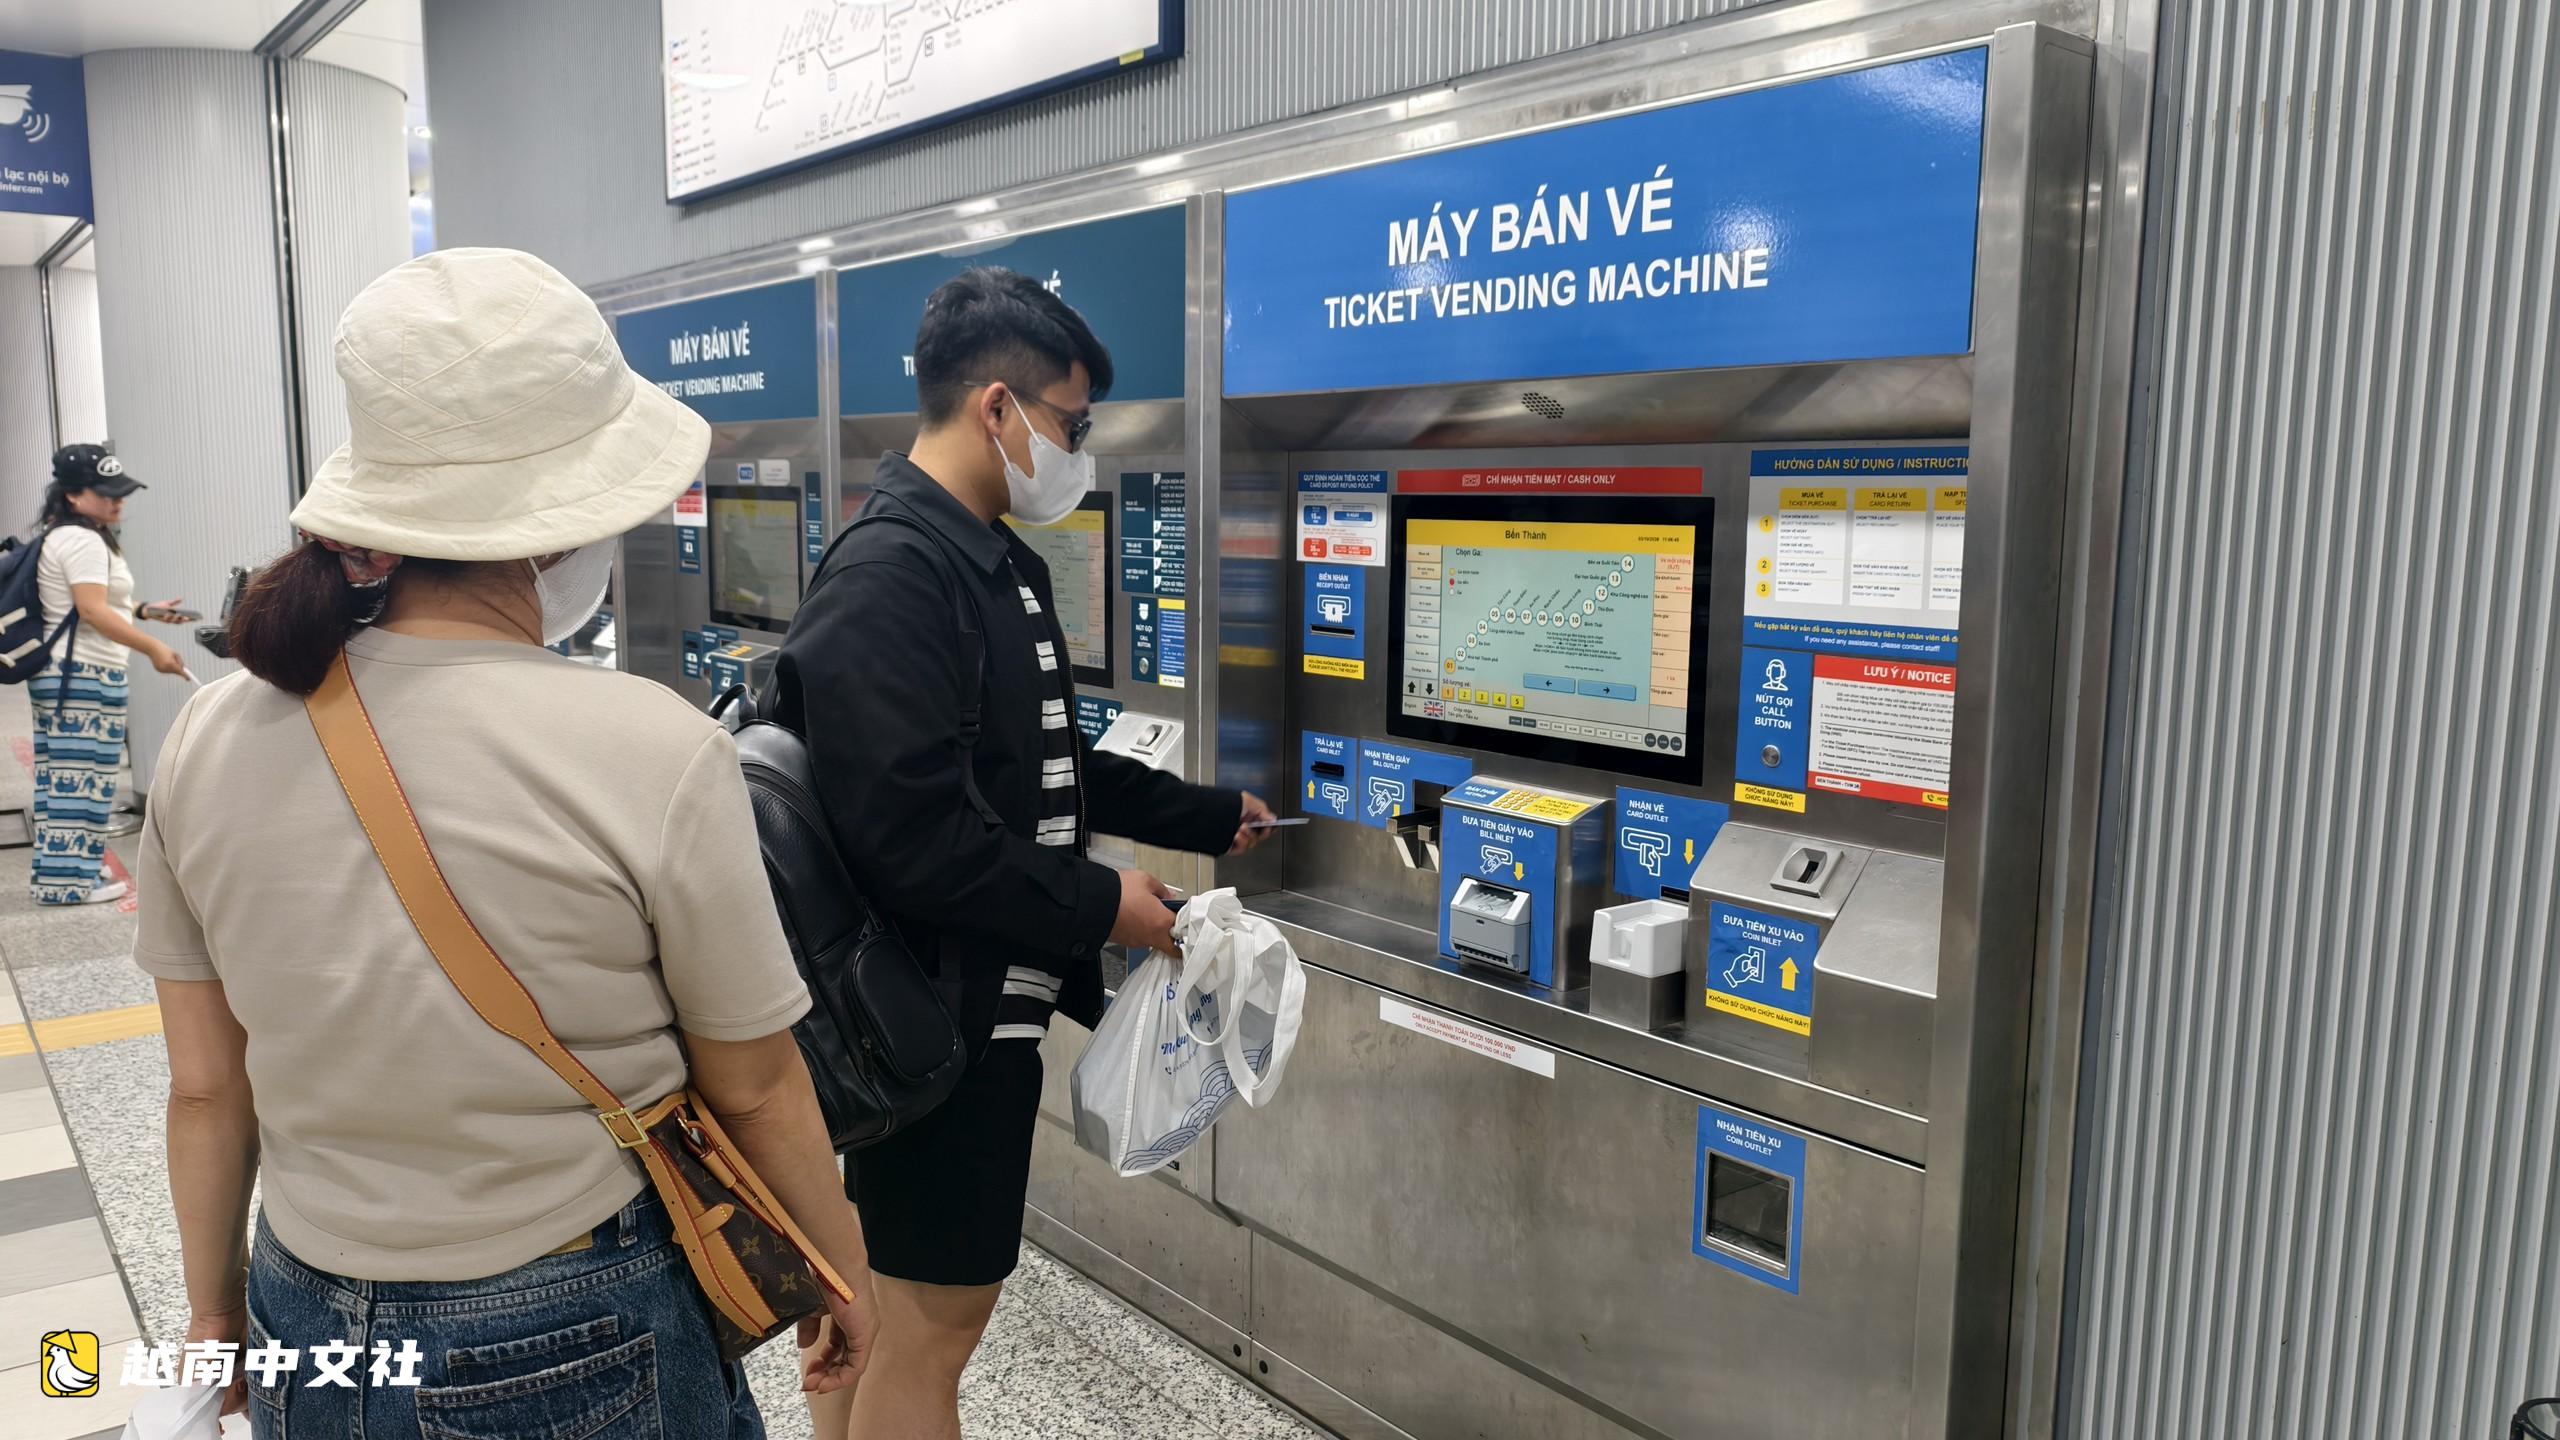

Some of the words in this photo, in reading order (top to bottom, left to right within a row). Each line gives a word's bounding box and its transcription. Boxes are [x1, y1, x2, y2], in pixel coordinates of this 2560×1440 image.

[4, 167, 24, 183] lạc
[52, 171, 69, 188] bộ
[1388, 203, 1478, 267] MÁY
[1491, 185, 1588, 253] BÁN
[1606, 164, 1673, 236] VÉ
[1324, 286, 1424, 329] TICKET
[1429, 272, 1576, 317] VENDING
[1588, 247, 1769, 304] MACHINE
[670, 331, 700, 365] MÁY
[702, 326, 730, 361] BÁN
[731, 321, 750, 357] VÉ
[685, 376, 720, 396] VENDING
[722, 371, 764, 393] MACHINE
[1775, 458, 1814, 470] HƯỚNG
[1817, 457, 1840, 469] DẪN
[1844, 457, 1860, 470] SỬ
[1862, 457, 1894, 471] DỤNG
[1897, 457, 1901, 469] /
[1903, 457, 1968, 469] INSTRUCTI
[1486, 473, 1500, 485] CHỈ
[1501, 475, 1523, 487] NHẬN
[1525, 473, 1542, 485] TIỀN
[1544, 474, 1562, 487] MẶT
[1563, 475, 1567, 485] /
[1568, 475, 1592, 485] CASH
[1593, 475, 1616, 485] ONLY
[1816, 489, 1824, 498] VÉ
[1505, 528, 1520, 539] Bến
[1523, 530, 1547, 540] Thành
[1624, 559, 1632, 567] 14
[1762, 560, 1767, 568] 2
[1611, 575, 1619, 583] 13
[1598, 589, 1606, 597] 12
[1761, 584, 1766, 592] 3
[1585, 603, 1592, 611] 11
[1555, 615, 1562, 623] 09
[1571, 616, 1579, 624] 10
[1864, 665, 1887, 678] LƯU
[1890, 666, 1899, 679] Ý
[1900, 670, 1905, 679] /
[1907, 671, 1952, 684] NOTICE
[1755, 693, 1774, 704] NÚT
[1776, 697, 1793, 708] GỌI
[1762, 706, 1786, 717] CALL
[1755, 717, 1792, 729] BUTTON
[1315, 737, 1326, 746] TRẢ
[1326, 740, 1335, 749] LẠI
[1336, 741, 1344, 749] VÉ
[1383, 762, 1401, 770] OUTLET
[1745, 786, 1767, 796] KHÔNG
[1767, 789, 1776, 798] SỬ
[1776, 791, 1793, 801] DỤNG
[1629, 800, 1651, 814] NHẬN
[1653, 802, 1665, 813] VÉ
[1626, 810, 1644, 820] CARD
[1644, 812, 1669, 823] OUTLET
[1462, 815, 1479, 826] ĐƯA
[1480, 818, 1496, 830] TIỀN
[1497, 821, 1516, 834] GIẤY
[1517, 827, 1534, 838] VÀO
[1480, 829, 1494, 840] BILL
[1495, 833, 1514, 844] INLET
[1723, 914, 1744, 928] ĐƯA
[1745, 919, 1766, 932] TIỀN
[1767, 925, 1781, 936] XU
[1783, 927, 1804, 942] VÀO
[1742, 931, 1760, 942] COIN
[1761, 936, 1782, 947] INLET
[1709, 994, 1729, 1006] KHÔNG
[1730, 999, 1739, 1008] SỬ
[1740, 1004, 1756, 1014] DỤNG
[1757, 1008, 1775, 1019] CHỨC
[1776, 1013, 1794, 1024] NĂNG
[1717, 1119, 1743, 1136] NHẬN
[1745, 1128, 1766, 1144] TIỀN
[1768, 1136, 1782, 1149] XU
[1726, 1134, 1743, 1146] COIN
[1744, 1140, 1773, 1156] OUTLET
